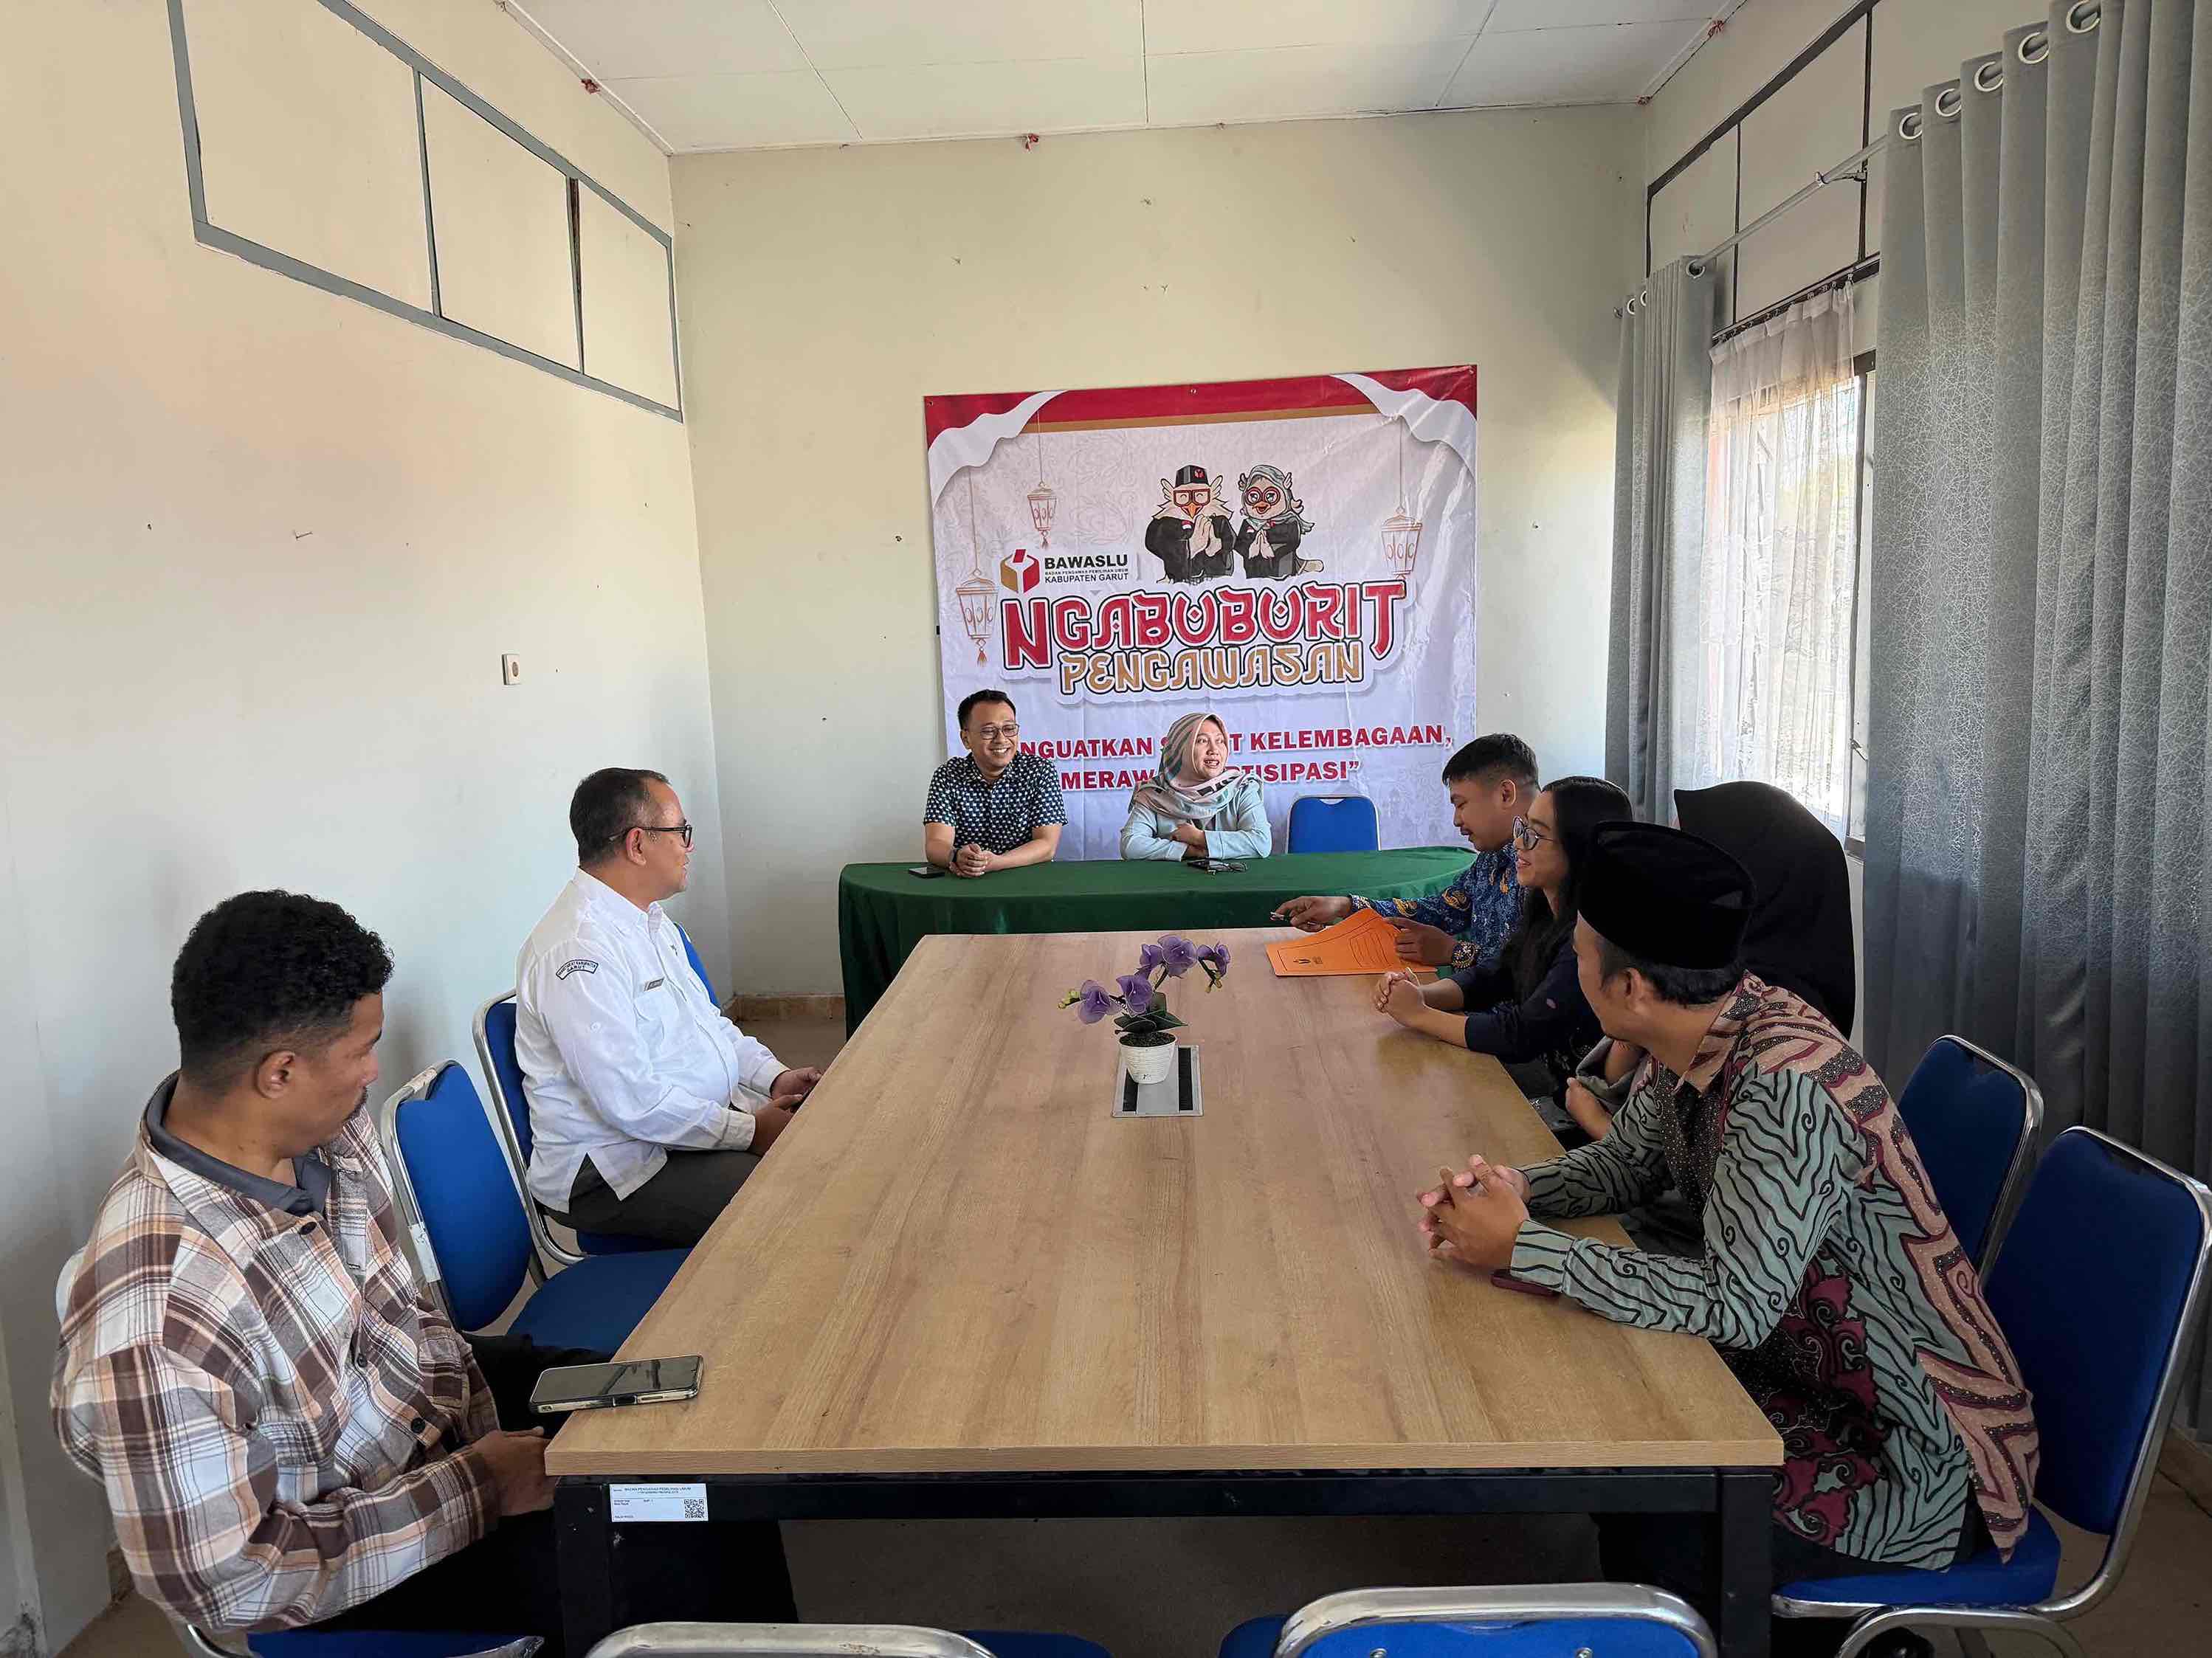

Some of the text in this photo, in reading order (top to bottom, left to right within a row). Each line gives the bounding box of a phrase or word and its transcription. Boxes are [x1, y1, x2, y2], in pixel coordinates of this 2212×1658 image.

[1044, 554, 1128, 569] BAWASLU
[1044, 573, 1128, 583] KABUPATEN GARUT
[1002, 581, 1405, 668] NGABUBURIT
[1060, 642, 1362, 693] PENGAWASAN
[1020, 737, 1152, 759] NGUATKAN
[1250, 725, 1452, 750] KELEMBAGAAN,
[1061, 769, 1155, 790] MERAW
